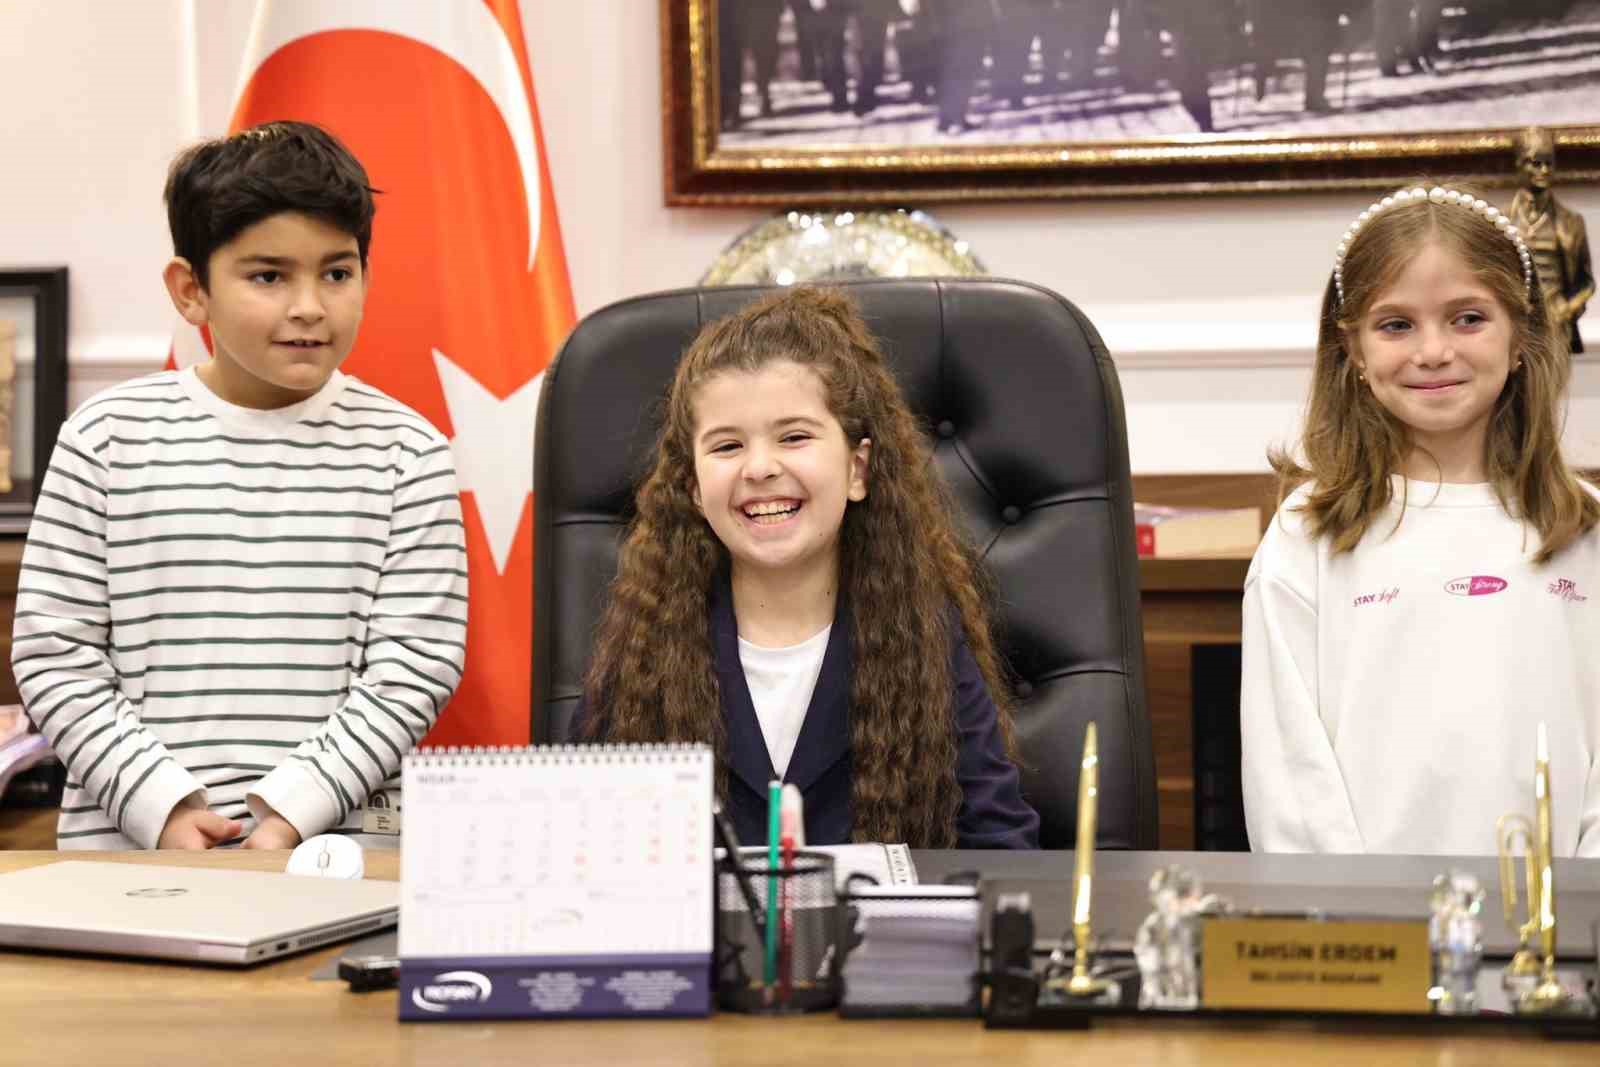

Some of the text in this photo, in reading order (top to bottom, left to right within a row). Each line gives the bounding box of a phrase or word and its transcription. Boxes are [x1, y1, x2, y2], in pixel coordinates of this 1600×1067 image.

[1450, 583, 1470, 591] STAY
[1353, 593, 1376, 608] STAY
[1320, 943, 1397, 962] ERDEM
